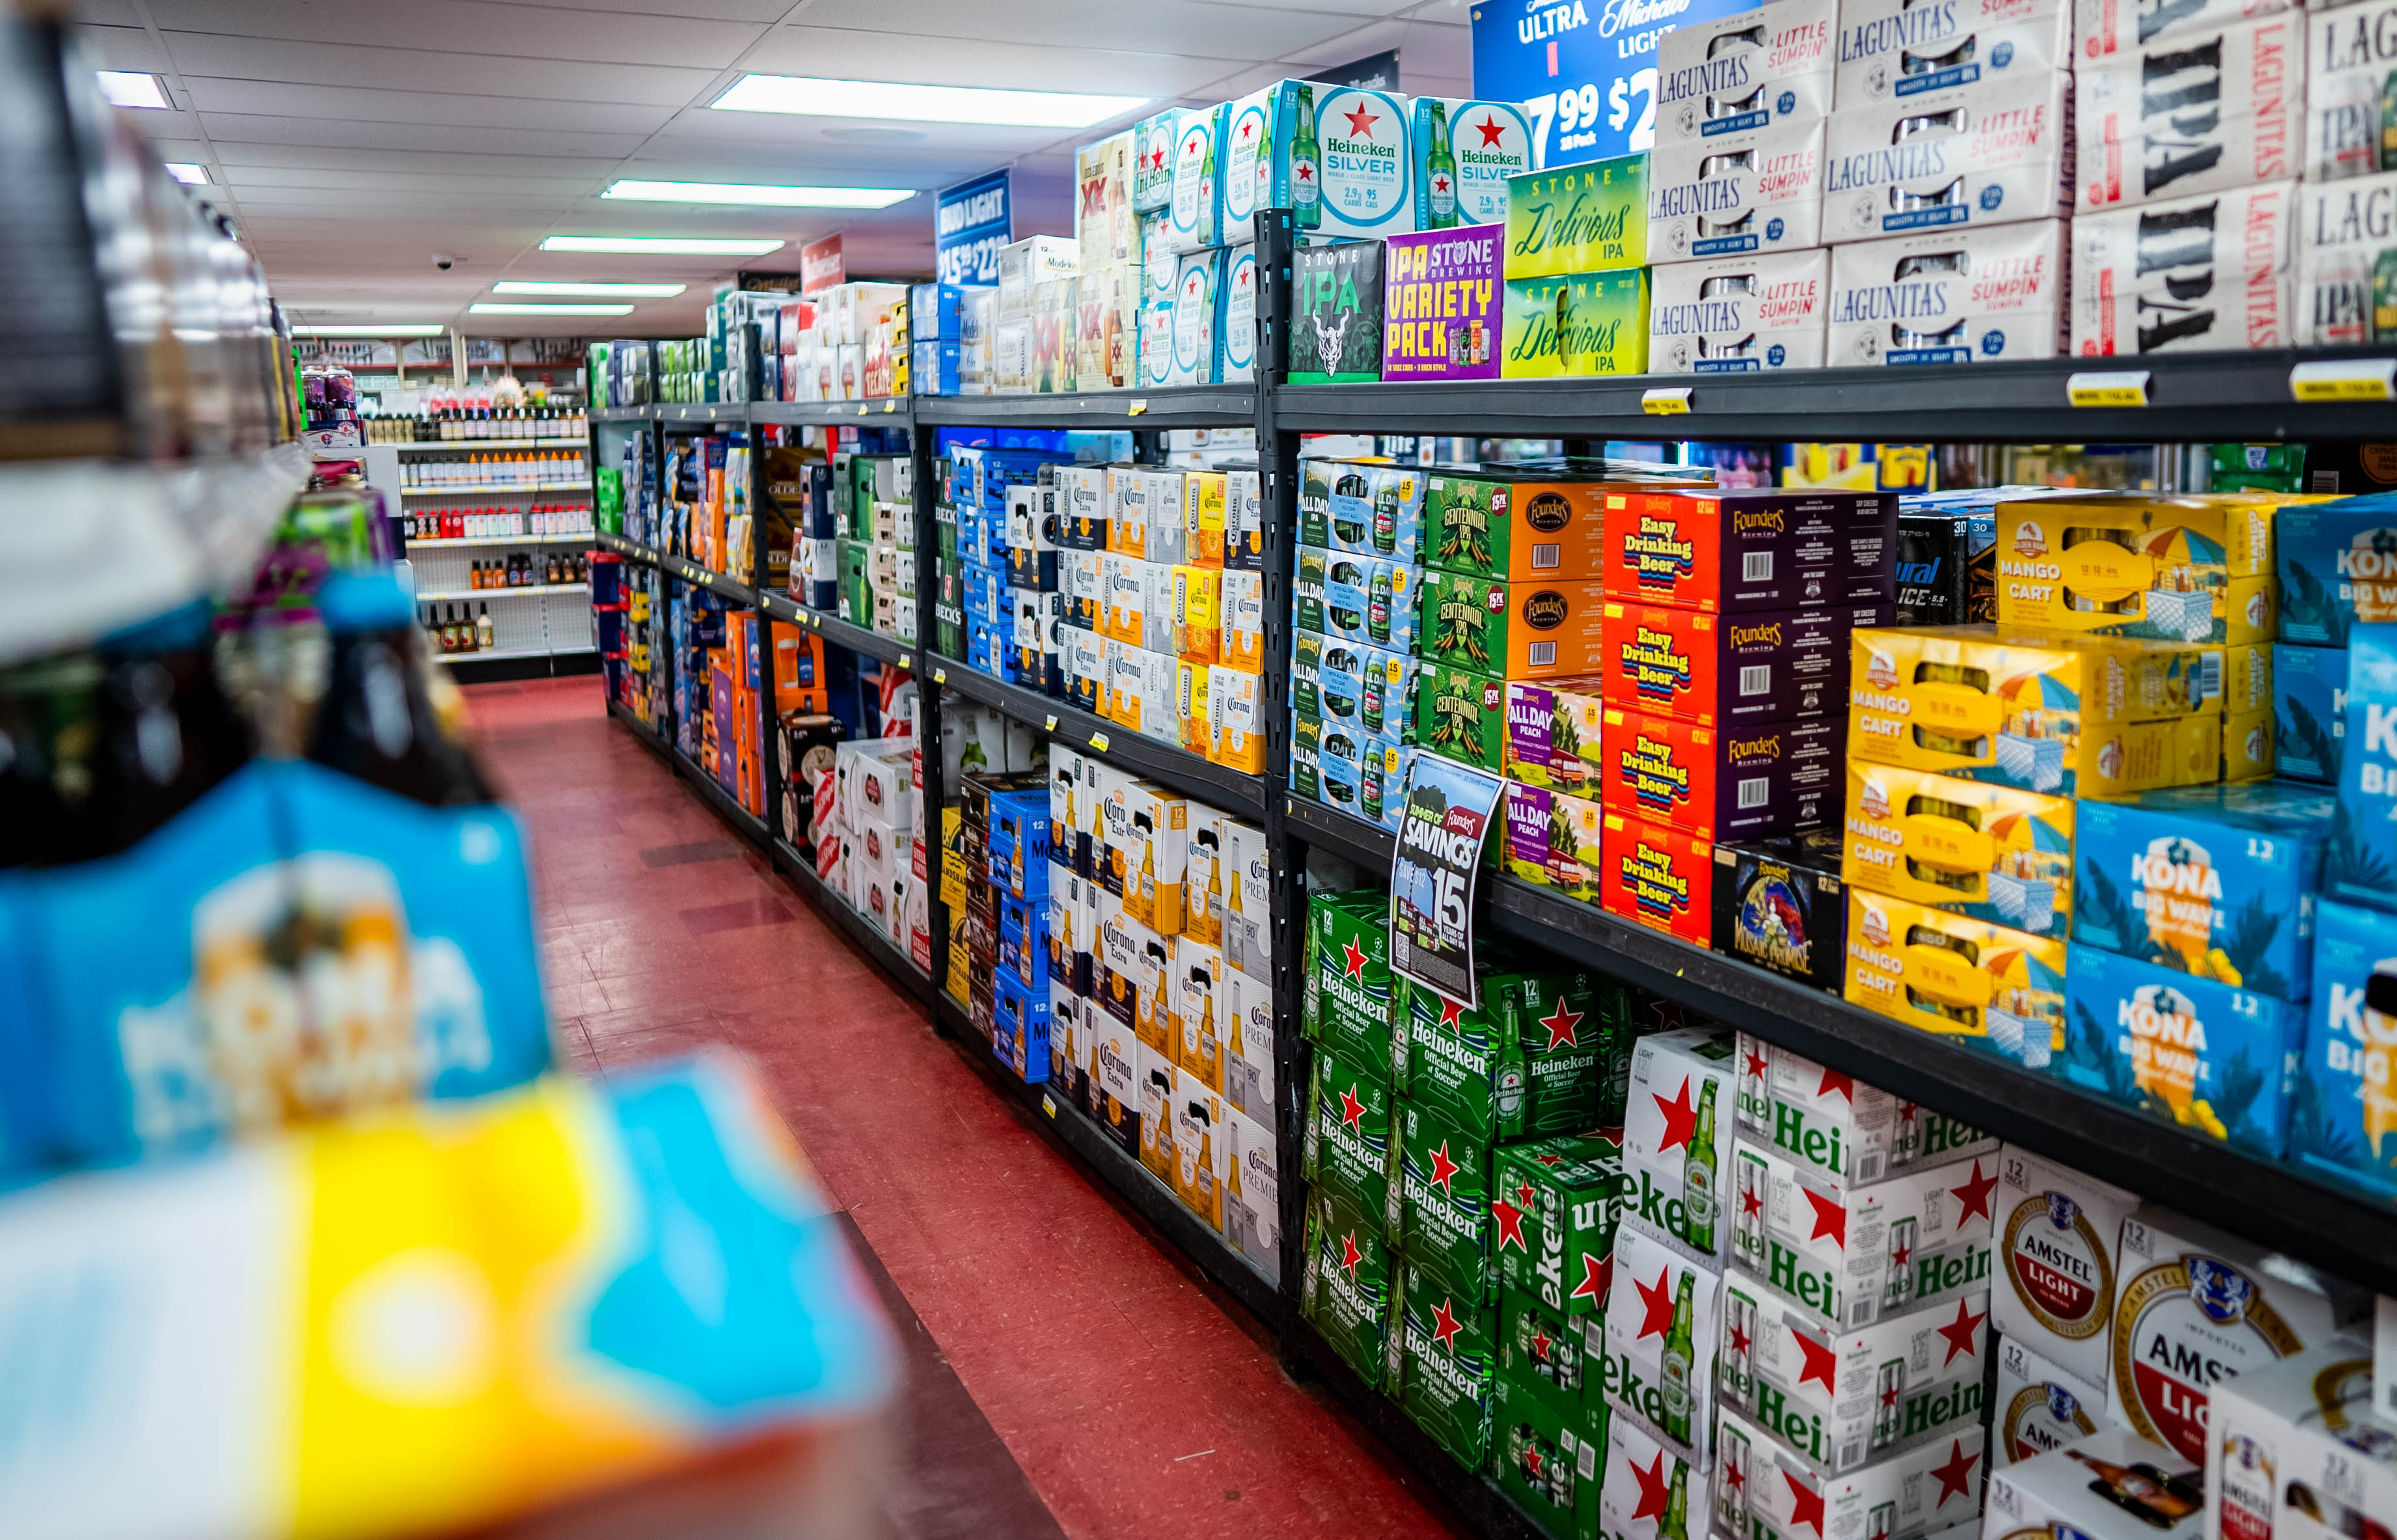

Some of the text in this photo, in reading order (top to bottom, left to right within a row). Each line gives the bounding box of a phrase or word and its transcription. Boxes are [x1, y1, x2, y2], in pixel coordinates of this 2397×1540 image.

[1519, 0, 1589, 44] ULTRA
[1776, 20, 1827, 47] LITTLE
[1659, 55, 1748, 103] LAGUNITAS
[2252, 22, 2287, 180] LAGUNITAS
[1982, 105, 2045, 134] LITTLE
[2139, 34, 2225, 196] IPA
[1233, 152, 1255, 166] SILVER
[1328, 138, 1395, 158] Heineken
[1462, 150, 1522, 165] Heineken
[1328, 156, 1395, 174] SILVER
[1828, 141, 1945, 191] LAGUNITAS
[1367, 189, 1377, 200] 95
[1532, 169, 1611, 196] STONE
[1344, 198, 1378, 208] CARBS CALS
[1651, 177, 1740, 219] LAGUNITAS
[1514, 193, 1630, 256] Delicious
[1305, 249, 1358, 267] STONE
[1432, 238, 1493, 266] STONE
[1604, 243, 1624, 259] IPA
[1390, 245, 1429, 282] IPA
[1432, 265, 1492, 278] BREWING
[2243, 190, 2279, 350] LAGUNITAS
[2137, 199, 2219, 353] IPA
[1303, 270, 1363, 316] IPA
[1389, 279, 1492, 320] VARIETY
[1526, 281, 1603, 303] STONE
[1768, 280, 1817, 299] LITTLE
[1833, 281, 1947, 322] LAGUNITAS
[1653, 301, 1740, 335] LAGUNITAS
[1388, 321, 1447, 357] PACK
[1595, 356, 1615, 372] IPA
[1074, 487, 1097, 504] Corona
[1080, 502, 1091, 512] Extra
[1205, 499, 1222, 511] Corona
[1301, 497, 1330, 516] ALL DAY
[1444, 508, 1486, 532] CENTENNIAL
[1530, 498, 1570, 519] Founders
[1459, 526, 1471, 540] IPA
[1641, 516, 1676, 538] Easy
[1734, 508, 1785, 534] Founders
[1954, 521, 1967, 533] 30
[1973, 523, 1987, 532] 30
[1624, 535, 1692, 560] Drinking
[1640, 554, 1675, 573] Beer
[2001, 560, 2062, 582] MANGO
[1114, 572, 1140, 593] Corona
[2008, 582, 2053, 603] CART
[1527, 596, 1566, 618] Founders
[1898, 588, 1930, 605] ICE
[935, 603, 961, 626] BECK'S
[1440, 603, 1483, 627] CENTENNIAL
[1297, 635, 1321, 656] Founders
[1637, 627, 1672, 650] Easy
[1731, 623, 1782, 650] Founders
[1116, 655, 1141, 679] Corona
[1622, 644, 1688, 673] Drinking
[1638, 665, 1673, 686] Beer
[1227, 696, 1250, 714] Corona
[1853, 689, 1911, 716] MANGO
[1509, 705, 1554, 731] ALL DAY
[1860, 715, 1905, 739] CART
[1520, 725, 1541, 738] PEACH
[1637, 736, 1671, 758] Easy
[1729, 734, 1780, 763] Founders
[1621, 751, 1688, 785] Drinking
[1637, 774, 1672, 795] Beer
[1174, 807, 1184, 818] 12
[1409, 803, 1443, 825] SUMMER OF
[1447, 810, 1475, 836] Founders
[1508, 803, 1552, 832] ALL DAY
[1033, 821, 1045, 830] 12
[1126, 823, 1144, 842] Corona
[1518, 823, 1539, 837] PEACH
[1847, 816, 1903, 846] MANGO
[1189, 842, 1209, 859] Corona
[1404, 816, 1475, 870] SAVINGS
[1854, 843, 1896, 867] CART
[2247, 837, 2274, 860] 12
[1399, 862, 1414, 879] SAVE
[2131, 852, 2223, 900] KONA
[1433, 867, 1466, 939] 15
[2131, 888, 2225, 929] BIG WAVE
[1104, 920, 1135, 955] Corona
[1246, 924, 1255, 936] 90
[1444, 926, 1457, 937] YEARS
[1449, 937, 1458, 946] DAY
[912, 933, 931, 960] STELLA
[1110, 944, 1127, 965] Extra
[1768, 939, 1813, 975] PROMISE
[912, 948, 931, 970] ARTOIS
[1034, 1003, 1047, 1013] 12
[1322, 969, 1388, 1023] Heineken
[1333, 998, 1370, 1028] Official Beer
[2117, 997, 2208, 1050] KONA
[1412, 1018, 1486, 1075] Heineken
[1637, 1048, 1654, 1062] LIGHT
[2118, 1034, 2211, 1082] BIG WAVE
[1099, 1041, 1132, 1082] Corona
[1424, 1048, 1468, 1081] Official Beer
[1531, 1055, 1594, 1076] Heineken
[1106, 1066, 1124, 1092] Extra
[1544, 1069, 1581, 1082] Official Beer
[1179, 1111, 1200, 1136] Corona
[2008, 1158, 2023, 1177] 12
[2004, 1173, 2025, 1188] PACK
[1404, 1173, 1478, 1239] Heineken
[2127, 1221, 2145, 1239] 12
[2025, 1235, 2091, 1283] AMSTEL
[1321, 1254, 1377, 1325] Heineken
[2029, 1263, 2080, 1303] LIGHT
[2127, 1269, 2182, 1307] AMSTEL
[2185, 1321, 2247, 1356] IMPORTED
[1405, 1321, 1479, 1401] Heineken
[2007, 1345, 2024, 1364] 12
